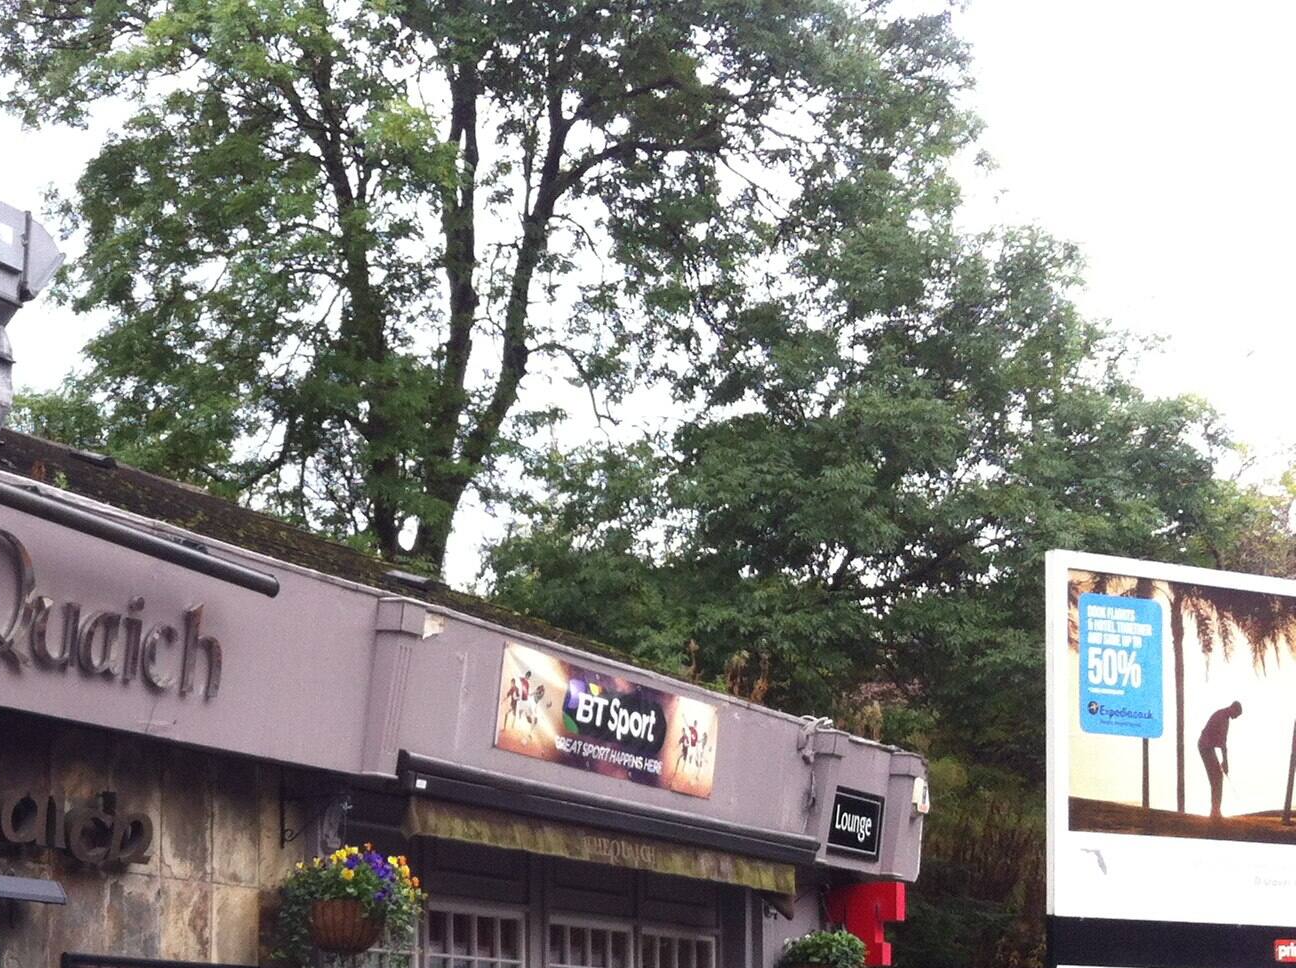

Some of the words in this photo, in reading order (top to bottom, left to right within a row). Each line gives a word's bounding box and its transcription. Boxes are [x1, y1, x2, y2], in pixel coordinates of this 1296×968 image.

[1088, 646, 1142, 688] 50%
[576, 692, 609, 727] BT
[608, 698, 656, 742] Sport
[555, 735, 582, 753] GREAT
[582, 742, 610, 760] SPORT
[835, 804, 872, 842] Lounge
